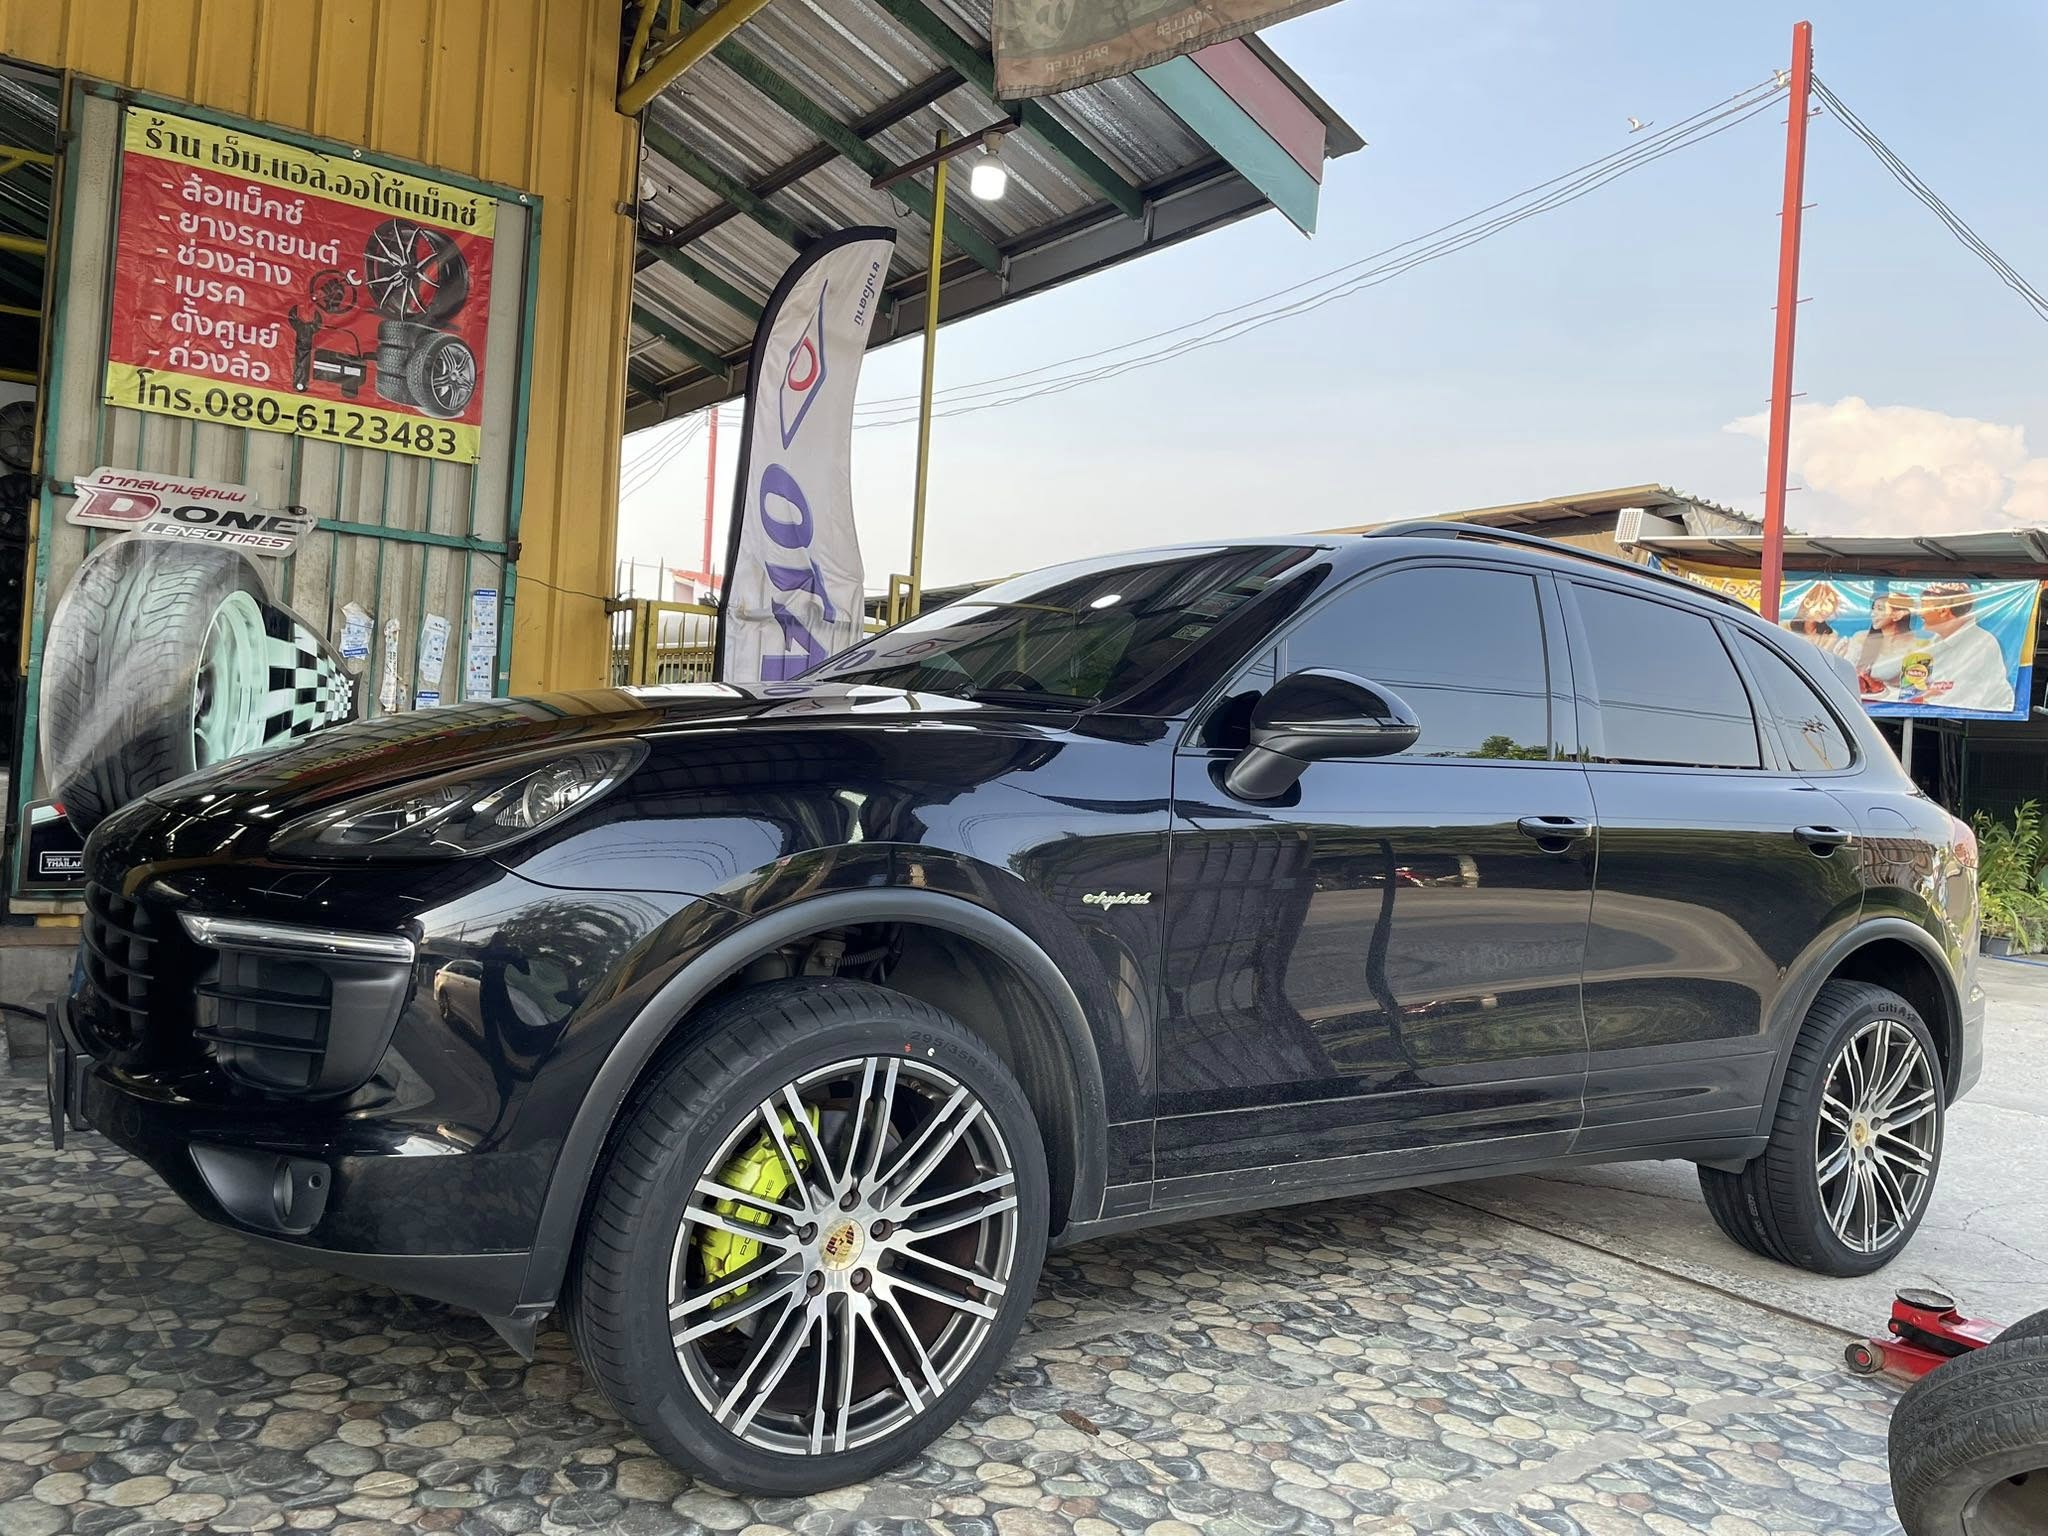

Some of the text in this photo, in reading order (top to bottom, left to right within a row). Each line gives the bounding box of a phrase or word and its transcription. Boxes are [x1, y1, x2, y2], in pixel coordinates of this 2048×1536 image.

[145, 117, 200, 160] ร้าน
[182, 173, 305, 225] ล้อแม็กซ์
[177, 238, 292, 285] ช่วงล่าง
[179, 211, 340, 266] ยางรถยนต์
[175, 274, 245, 307] เบรค
[171, 297, 281, 349] ตั้งศูนย์
[169, 340, 270, 382] ถ่วงล้อ
[147, 523, 292, 549] LENSO TIRES
[910, 1031, 990, 1077] 295/35R2
